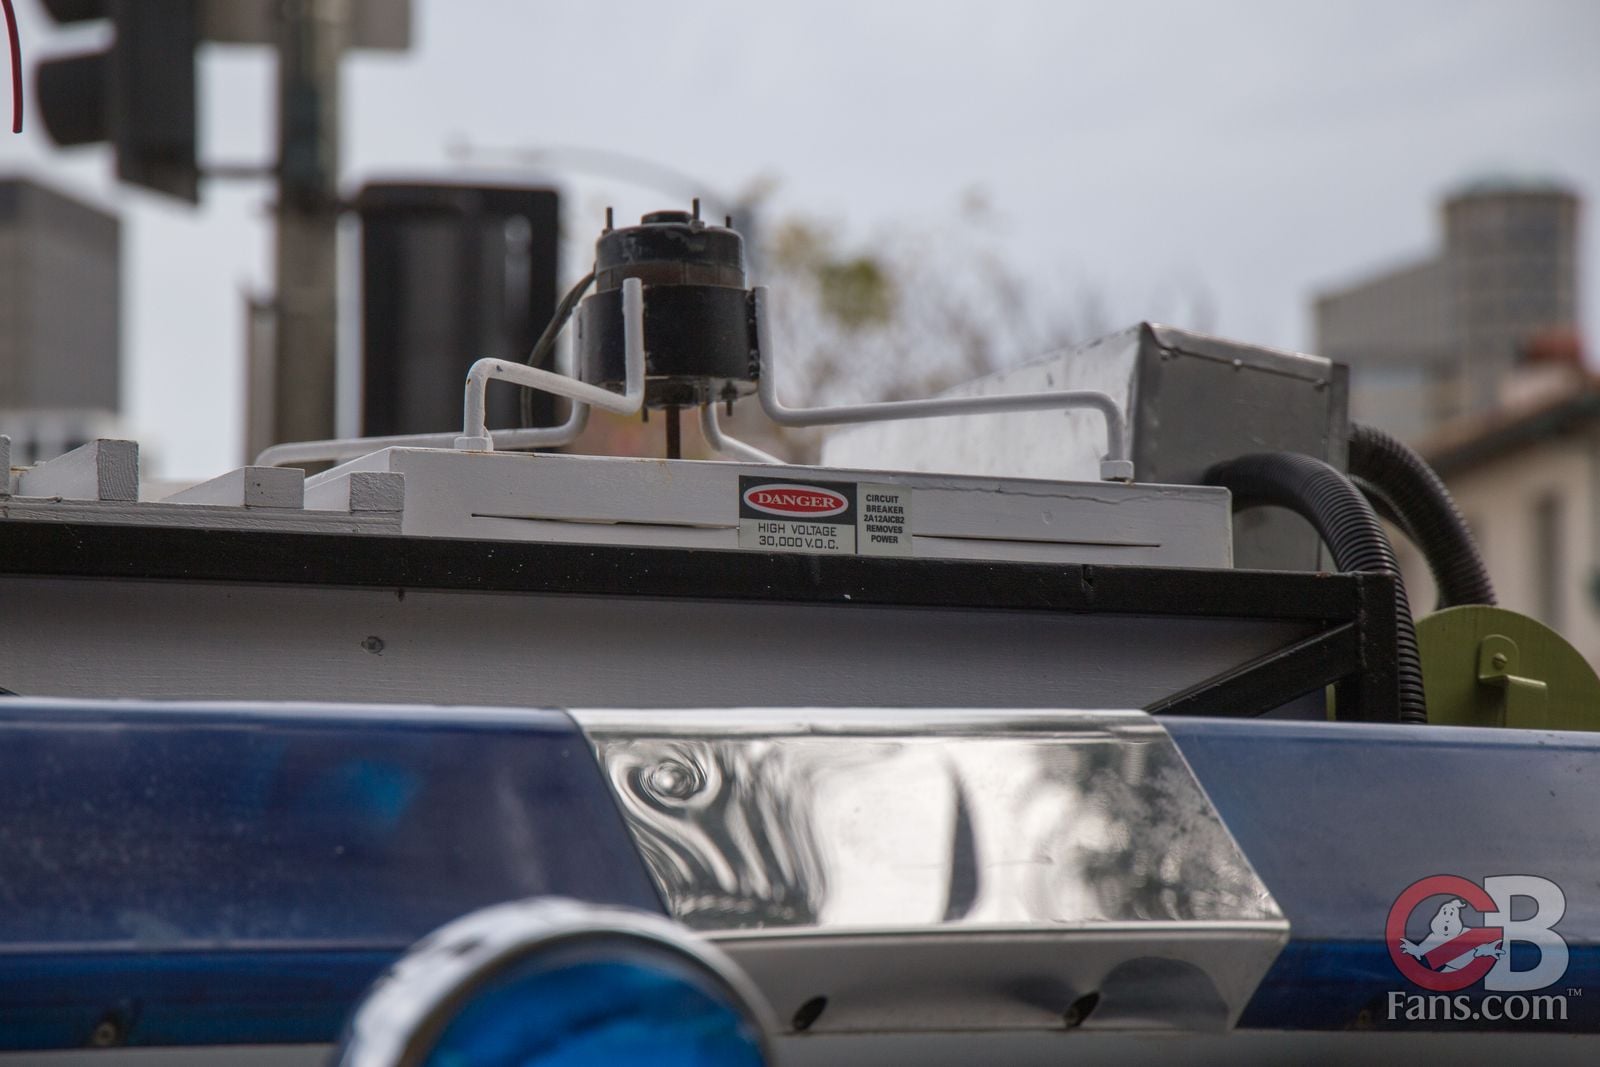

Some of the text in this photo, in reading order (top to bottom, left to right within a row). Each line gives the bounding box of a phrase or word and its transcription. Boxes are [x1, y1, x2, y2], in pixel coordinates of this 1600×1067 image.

[757, 492, 836, 508] DANGER
[866, 494, 899, 504] CIRCUIT
[866, 504, 904, 514] BREAKER
[758, 522, 837, 537] HIGH VOLTAGE
[866, 524, 903, 534] REMOVES
[759, 535, 802, 548] 30,000
[871, 534, 899, 544] POWER
